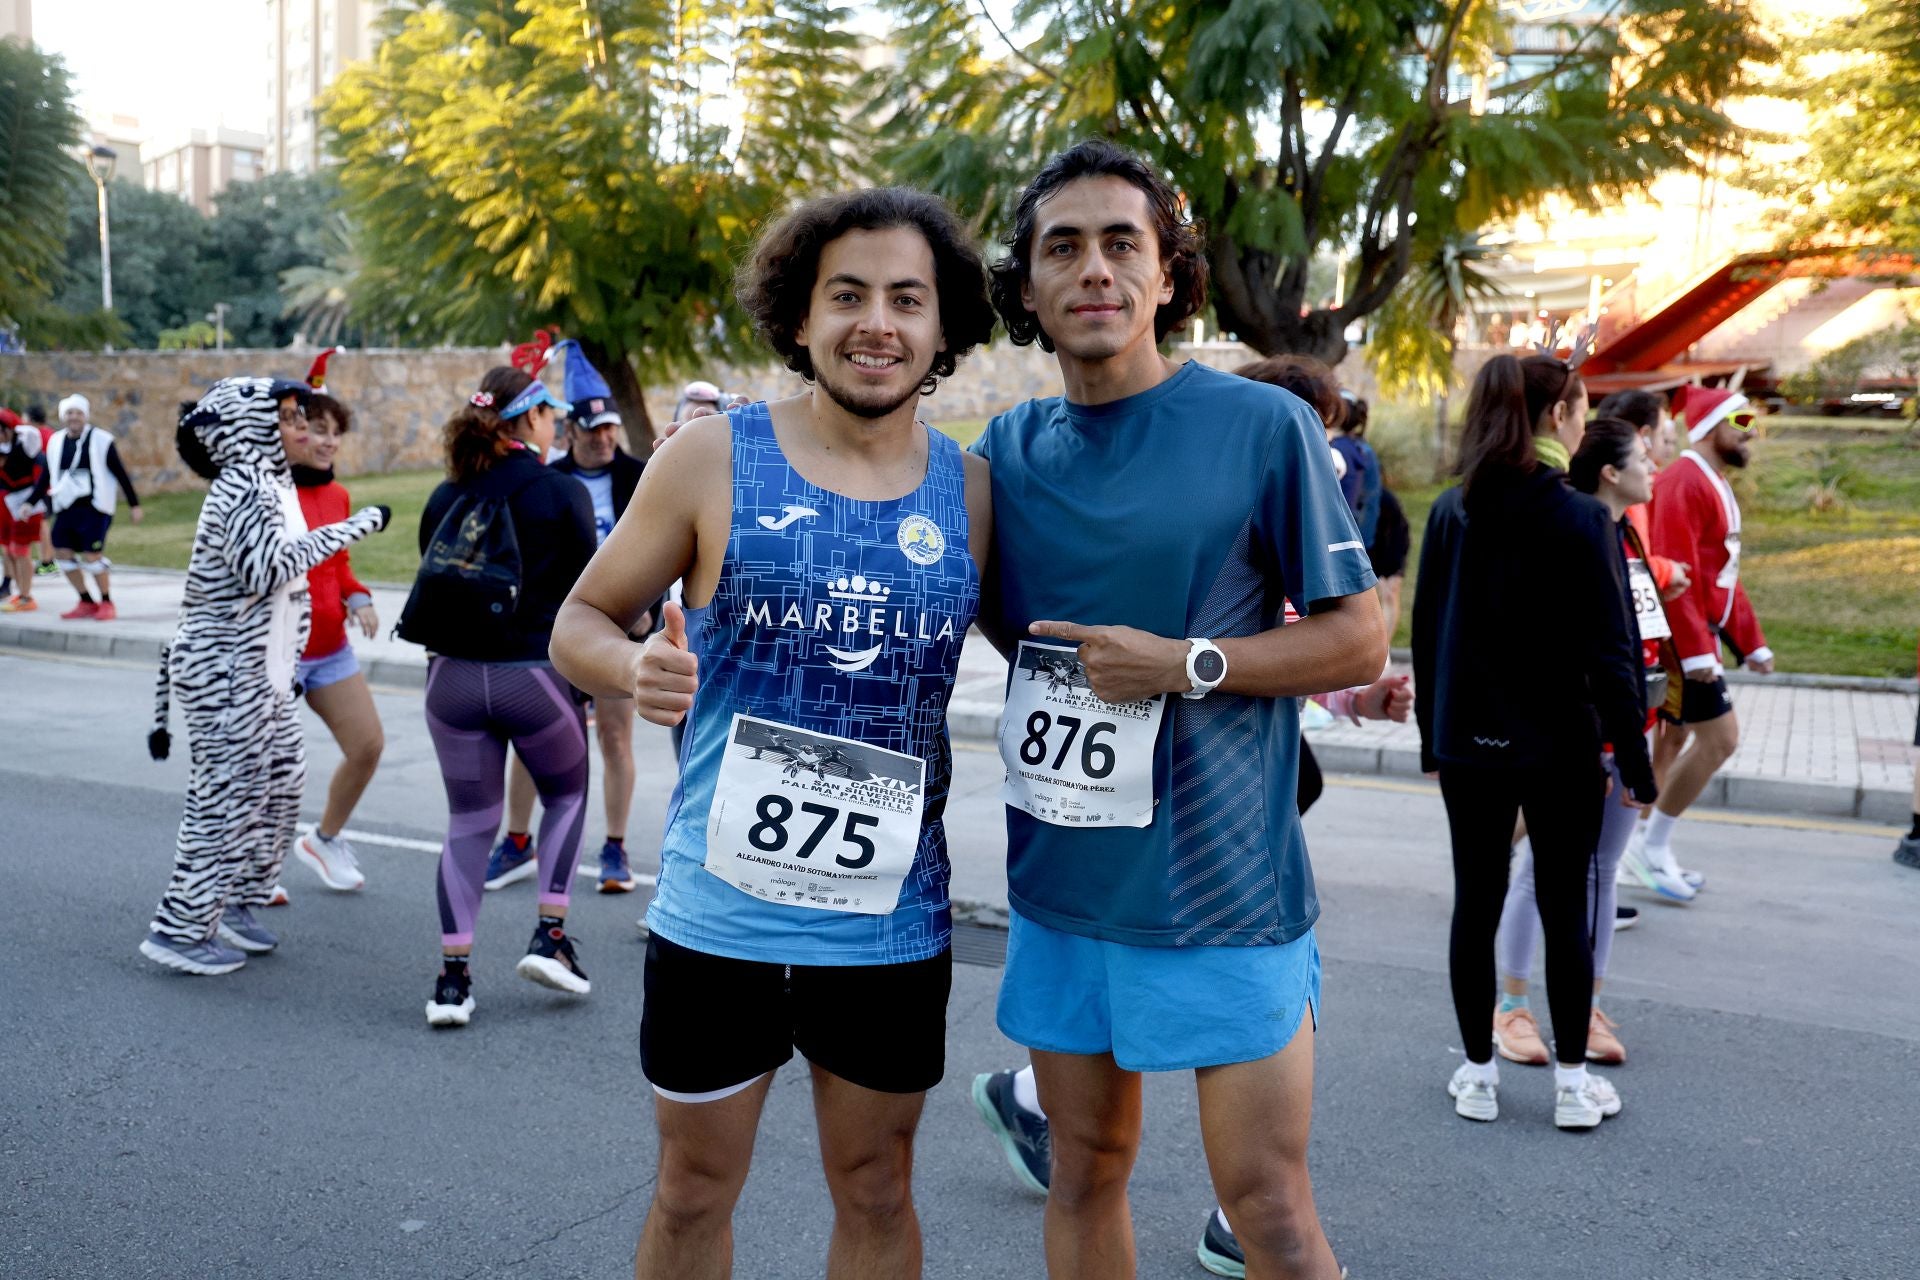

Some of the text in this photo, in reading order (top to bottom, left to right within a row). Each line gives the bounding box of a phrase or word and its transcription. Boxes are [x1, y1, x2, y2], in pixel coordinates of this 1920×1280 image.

[745, 599, 954, 643] MARBELLA
[1045, 695, 1078, 706] PALMA
[1081, 702, 1151, 718] PALMILLA
[1020, 710, 1117, 779] 876
[813, 780, 914, 807] SAN SILVESTRE
[850, 781, 915, 800] CARRERA
[860, 772, 920, 791] XIV
[1052, 777, 1089, 792] SOTOMAYOR
[1090, 784, 1116, 793] PÉREZ
[781, 779, 913, 812] PALMA PALMILLA
[748, 794, 880, 869] 875
[736, 852, 781, 868] ALEJANDRO
[782, 863, 806, 873] DAVID
[806, 867, 852, 880] SOTOMAYOR
[770, 877, 796, 887] málaga
